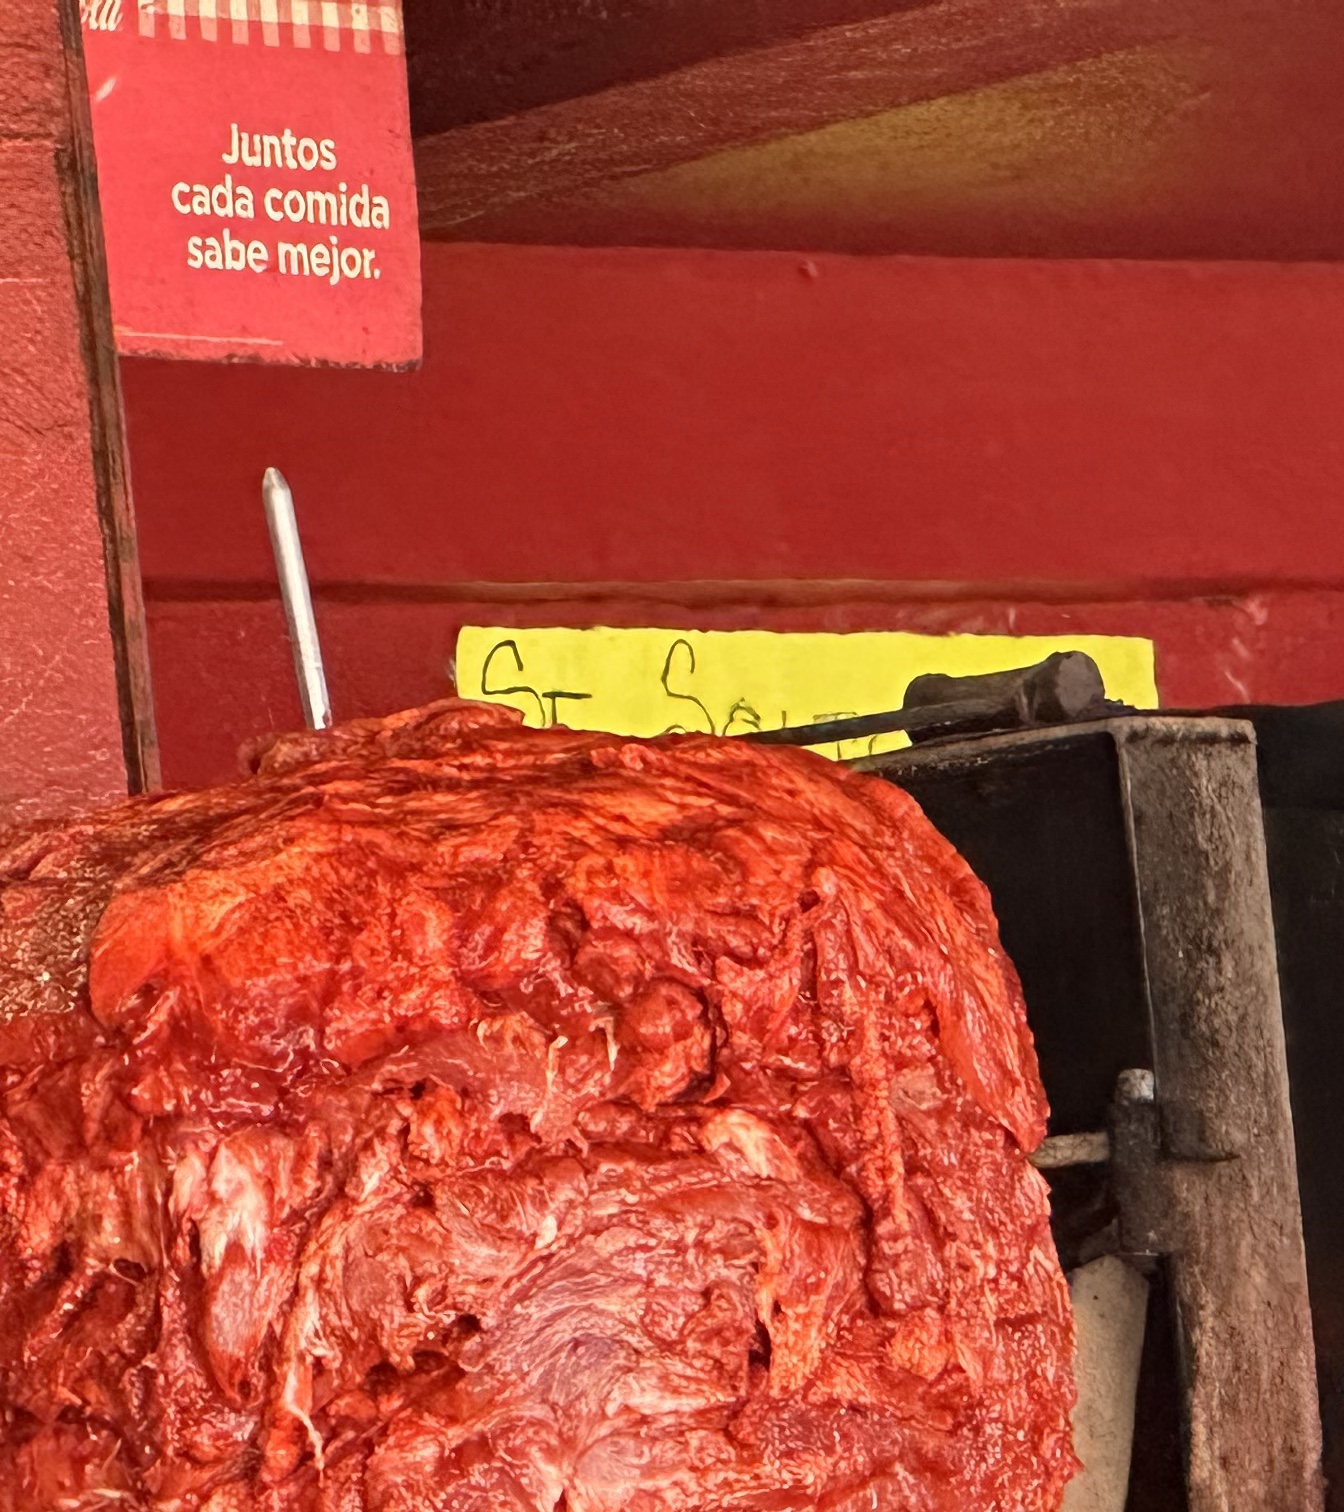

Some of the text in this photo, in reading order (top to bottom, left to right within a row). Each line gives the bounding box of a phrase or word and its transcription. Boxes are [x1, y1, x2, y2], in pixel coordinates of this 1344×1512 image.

[221, 122, 338, 171] Juntos
[171, 173, 391, 230] cada comida
[186, 228, 381, 286] sabe mejor.
